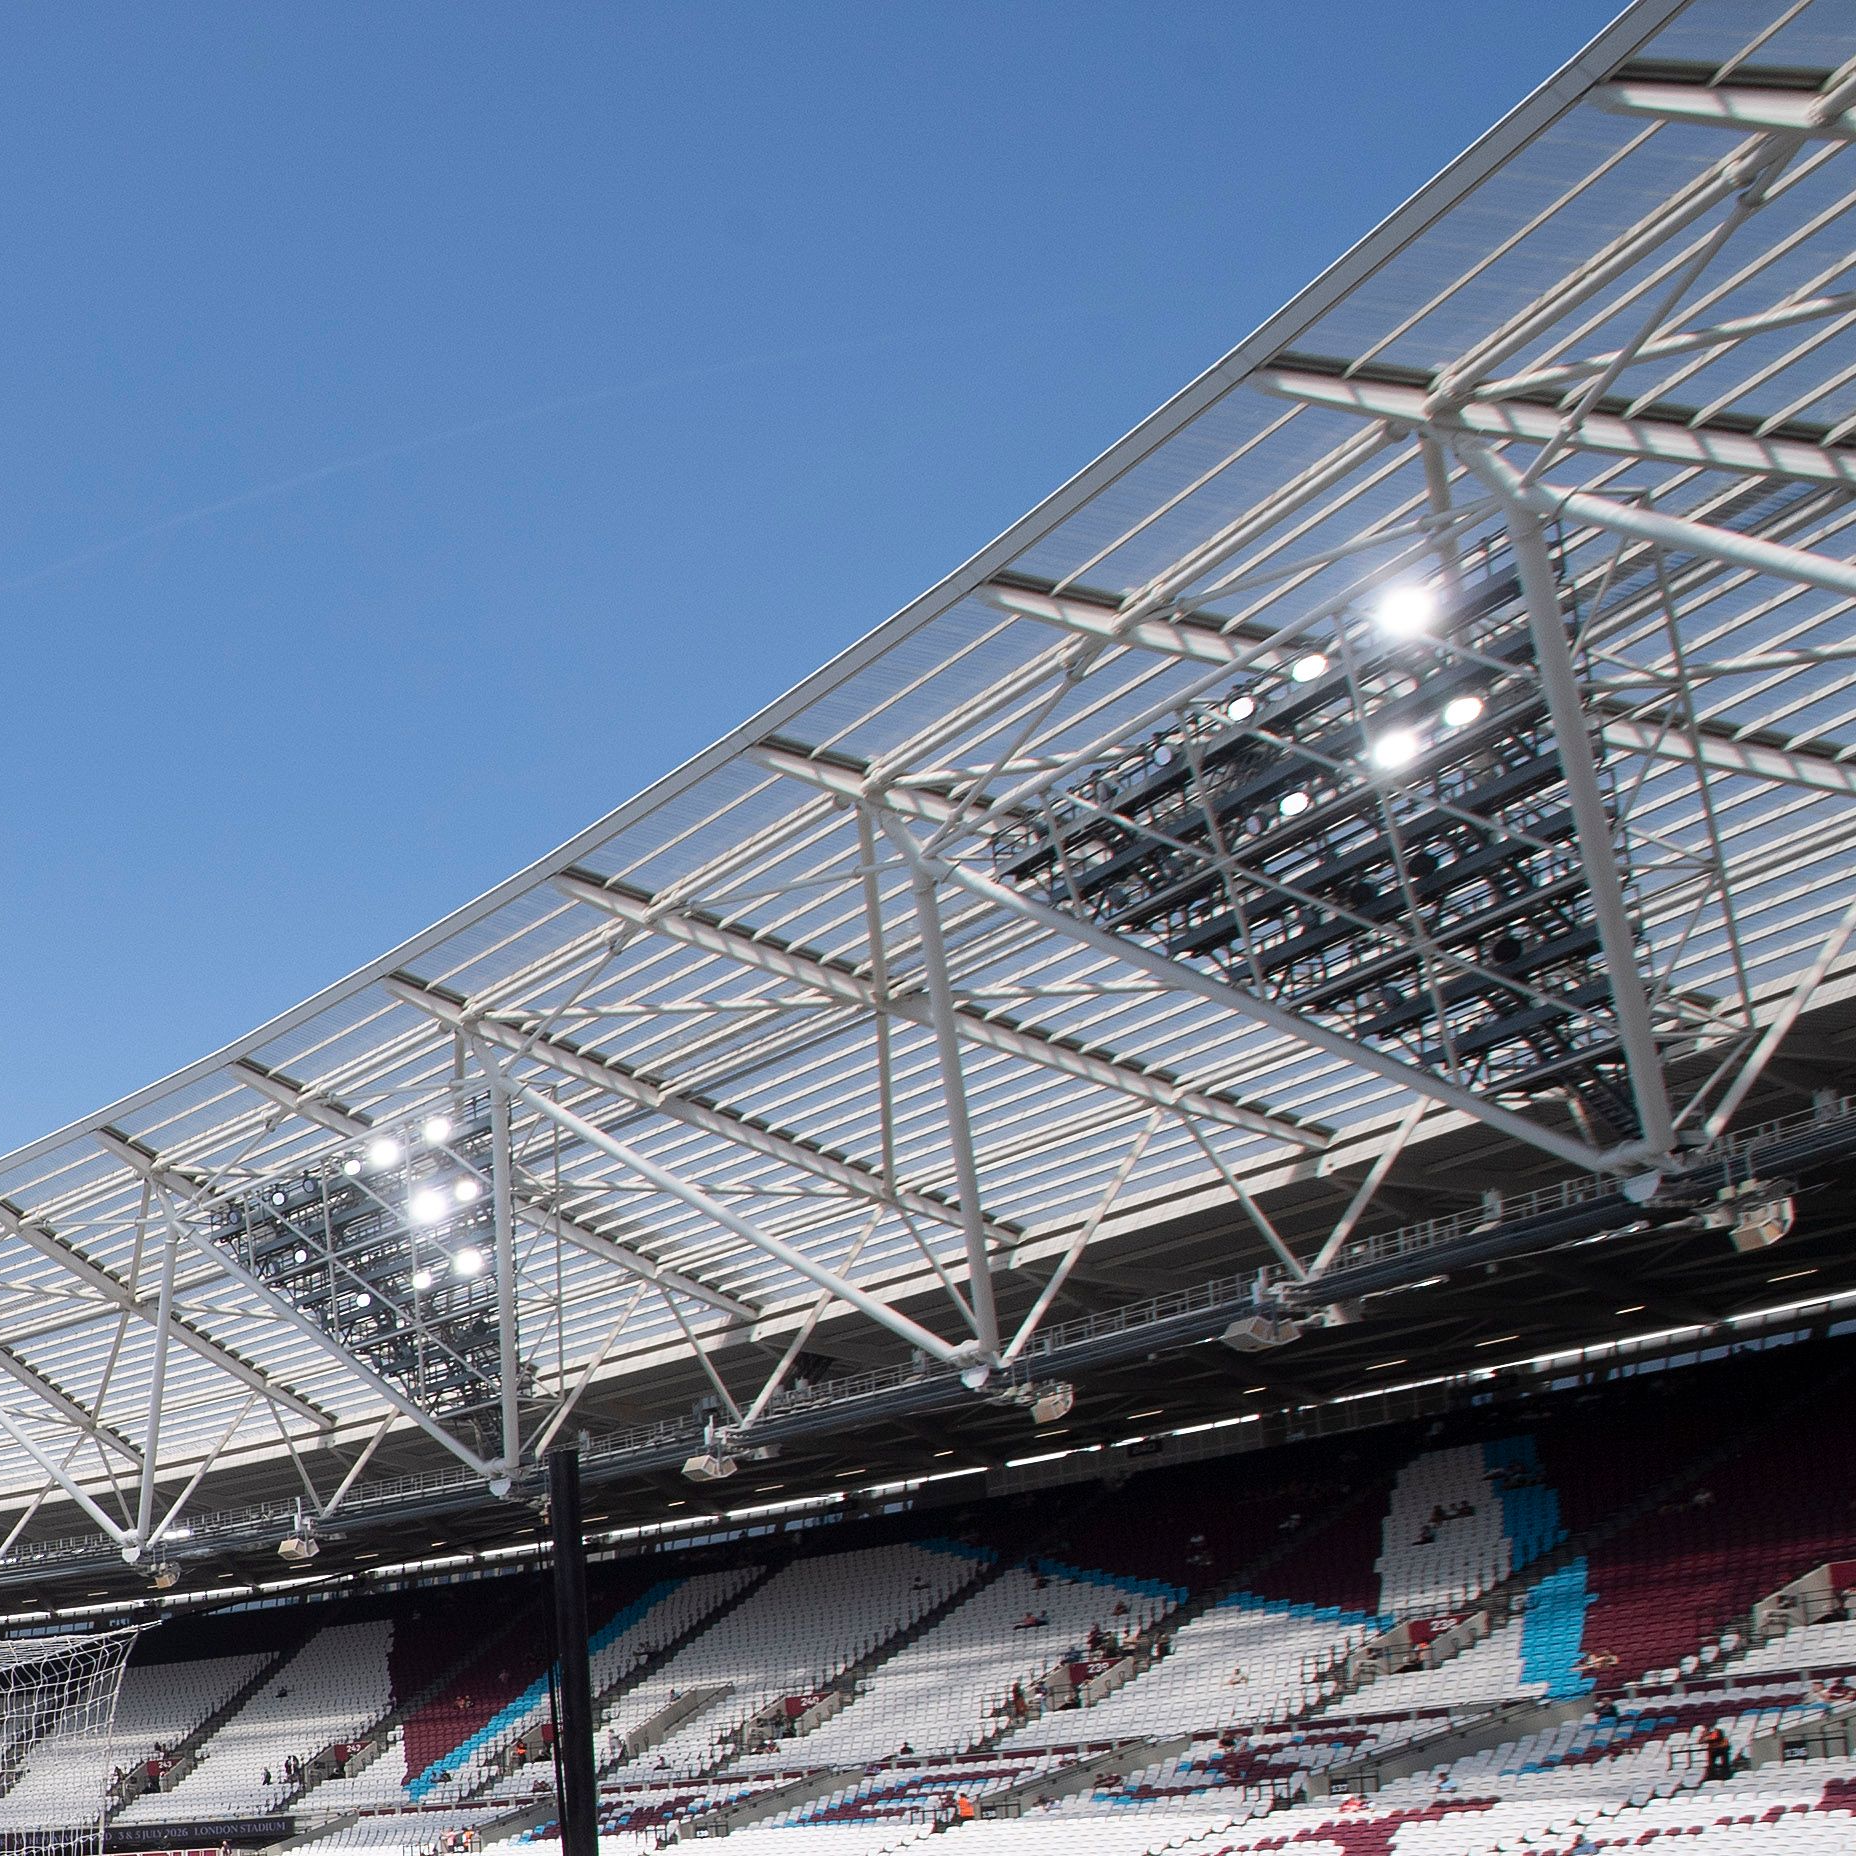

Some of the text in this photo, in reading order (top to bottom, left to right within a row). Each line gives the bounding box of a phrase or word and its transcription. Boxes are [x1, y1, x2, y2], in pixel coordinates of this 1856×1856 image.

[140, 1830, 163, 1841] JULY
[165, 1827, 189, 1838] 2026
[193, 1824, 238, 1837] LONDON
[239, 1821, 286, 1834] STADIUM
